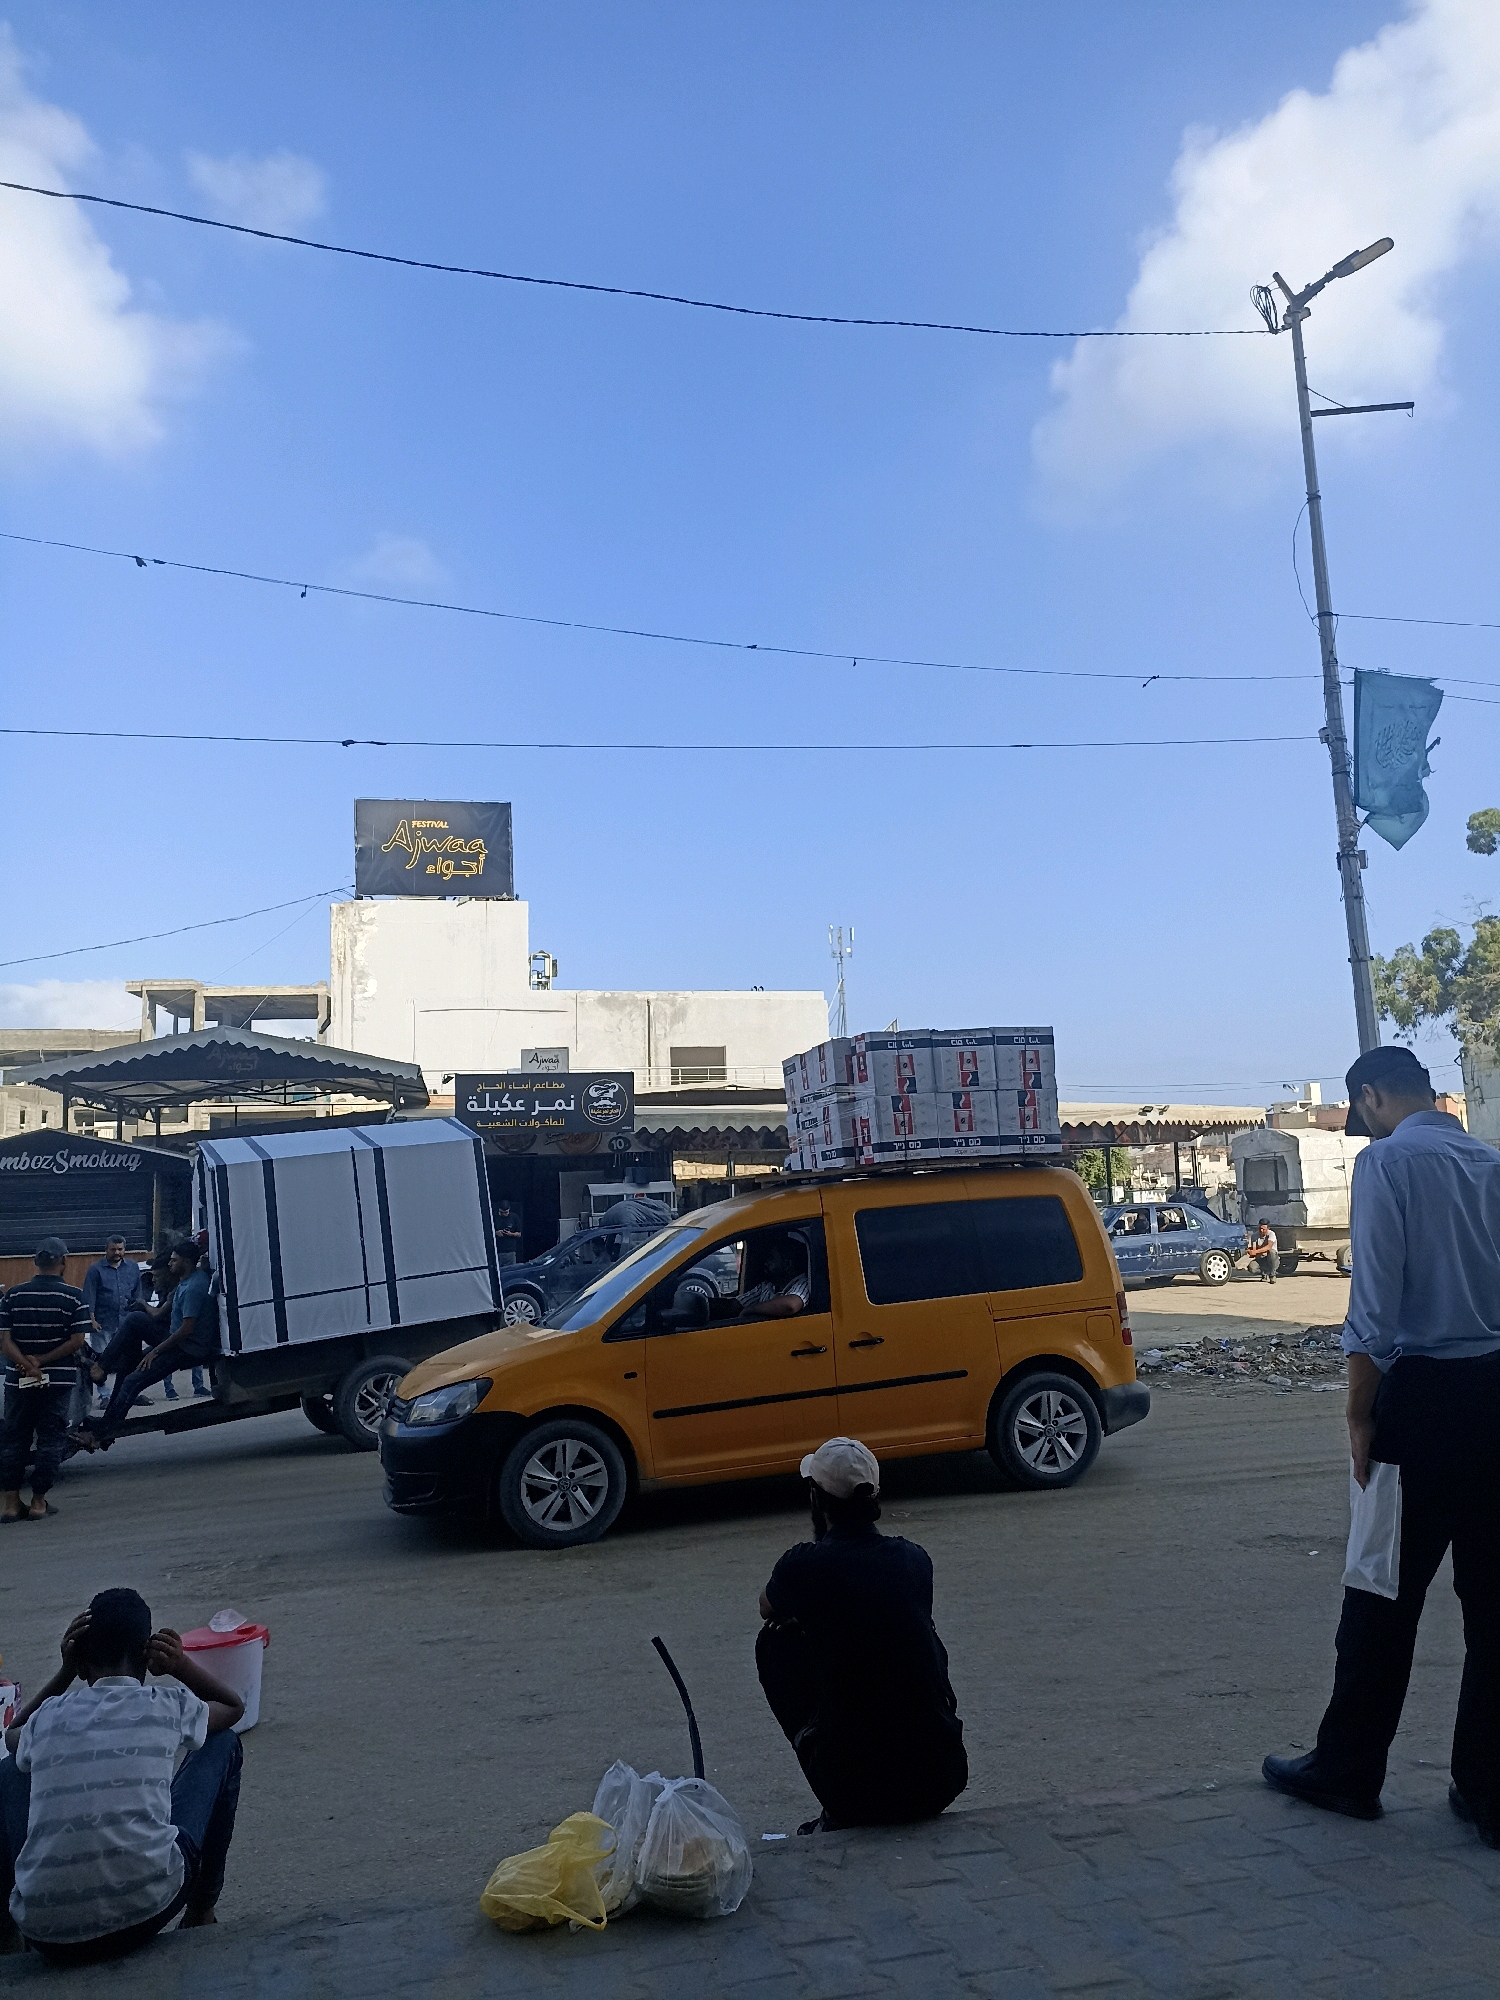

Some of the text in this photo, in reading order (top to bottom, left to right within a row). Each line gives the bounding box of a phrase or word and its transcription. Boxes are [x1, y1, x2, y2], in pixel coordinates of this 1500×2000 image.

[411, 820, 449, 829] FESTIVAL
[381, 819, 488, 870] Ajwaa
[426, 853, 486, 880] أجواء
[528, 1052, 560, 1070] Ajwaa
[476, 1079, 566, 1093] مطاعم أبناء الحاج
[466, 1092, 575, 1116] نمر عكيلة
[476, 1115, 565, 1129] للمأكولات الشعبية
[611, 1138, 625, 1150] 10
